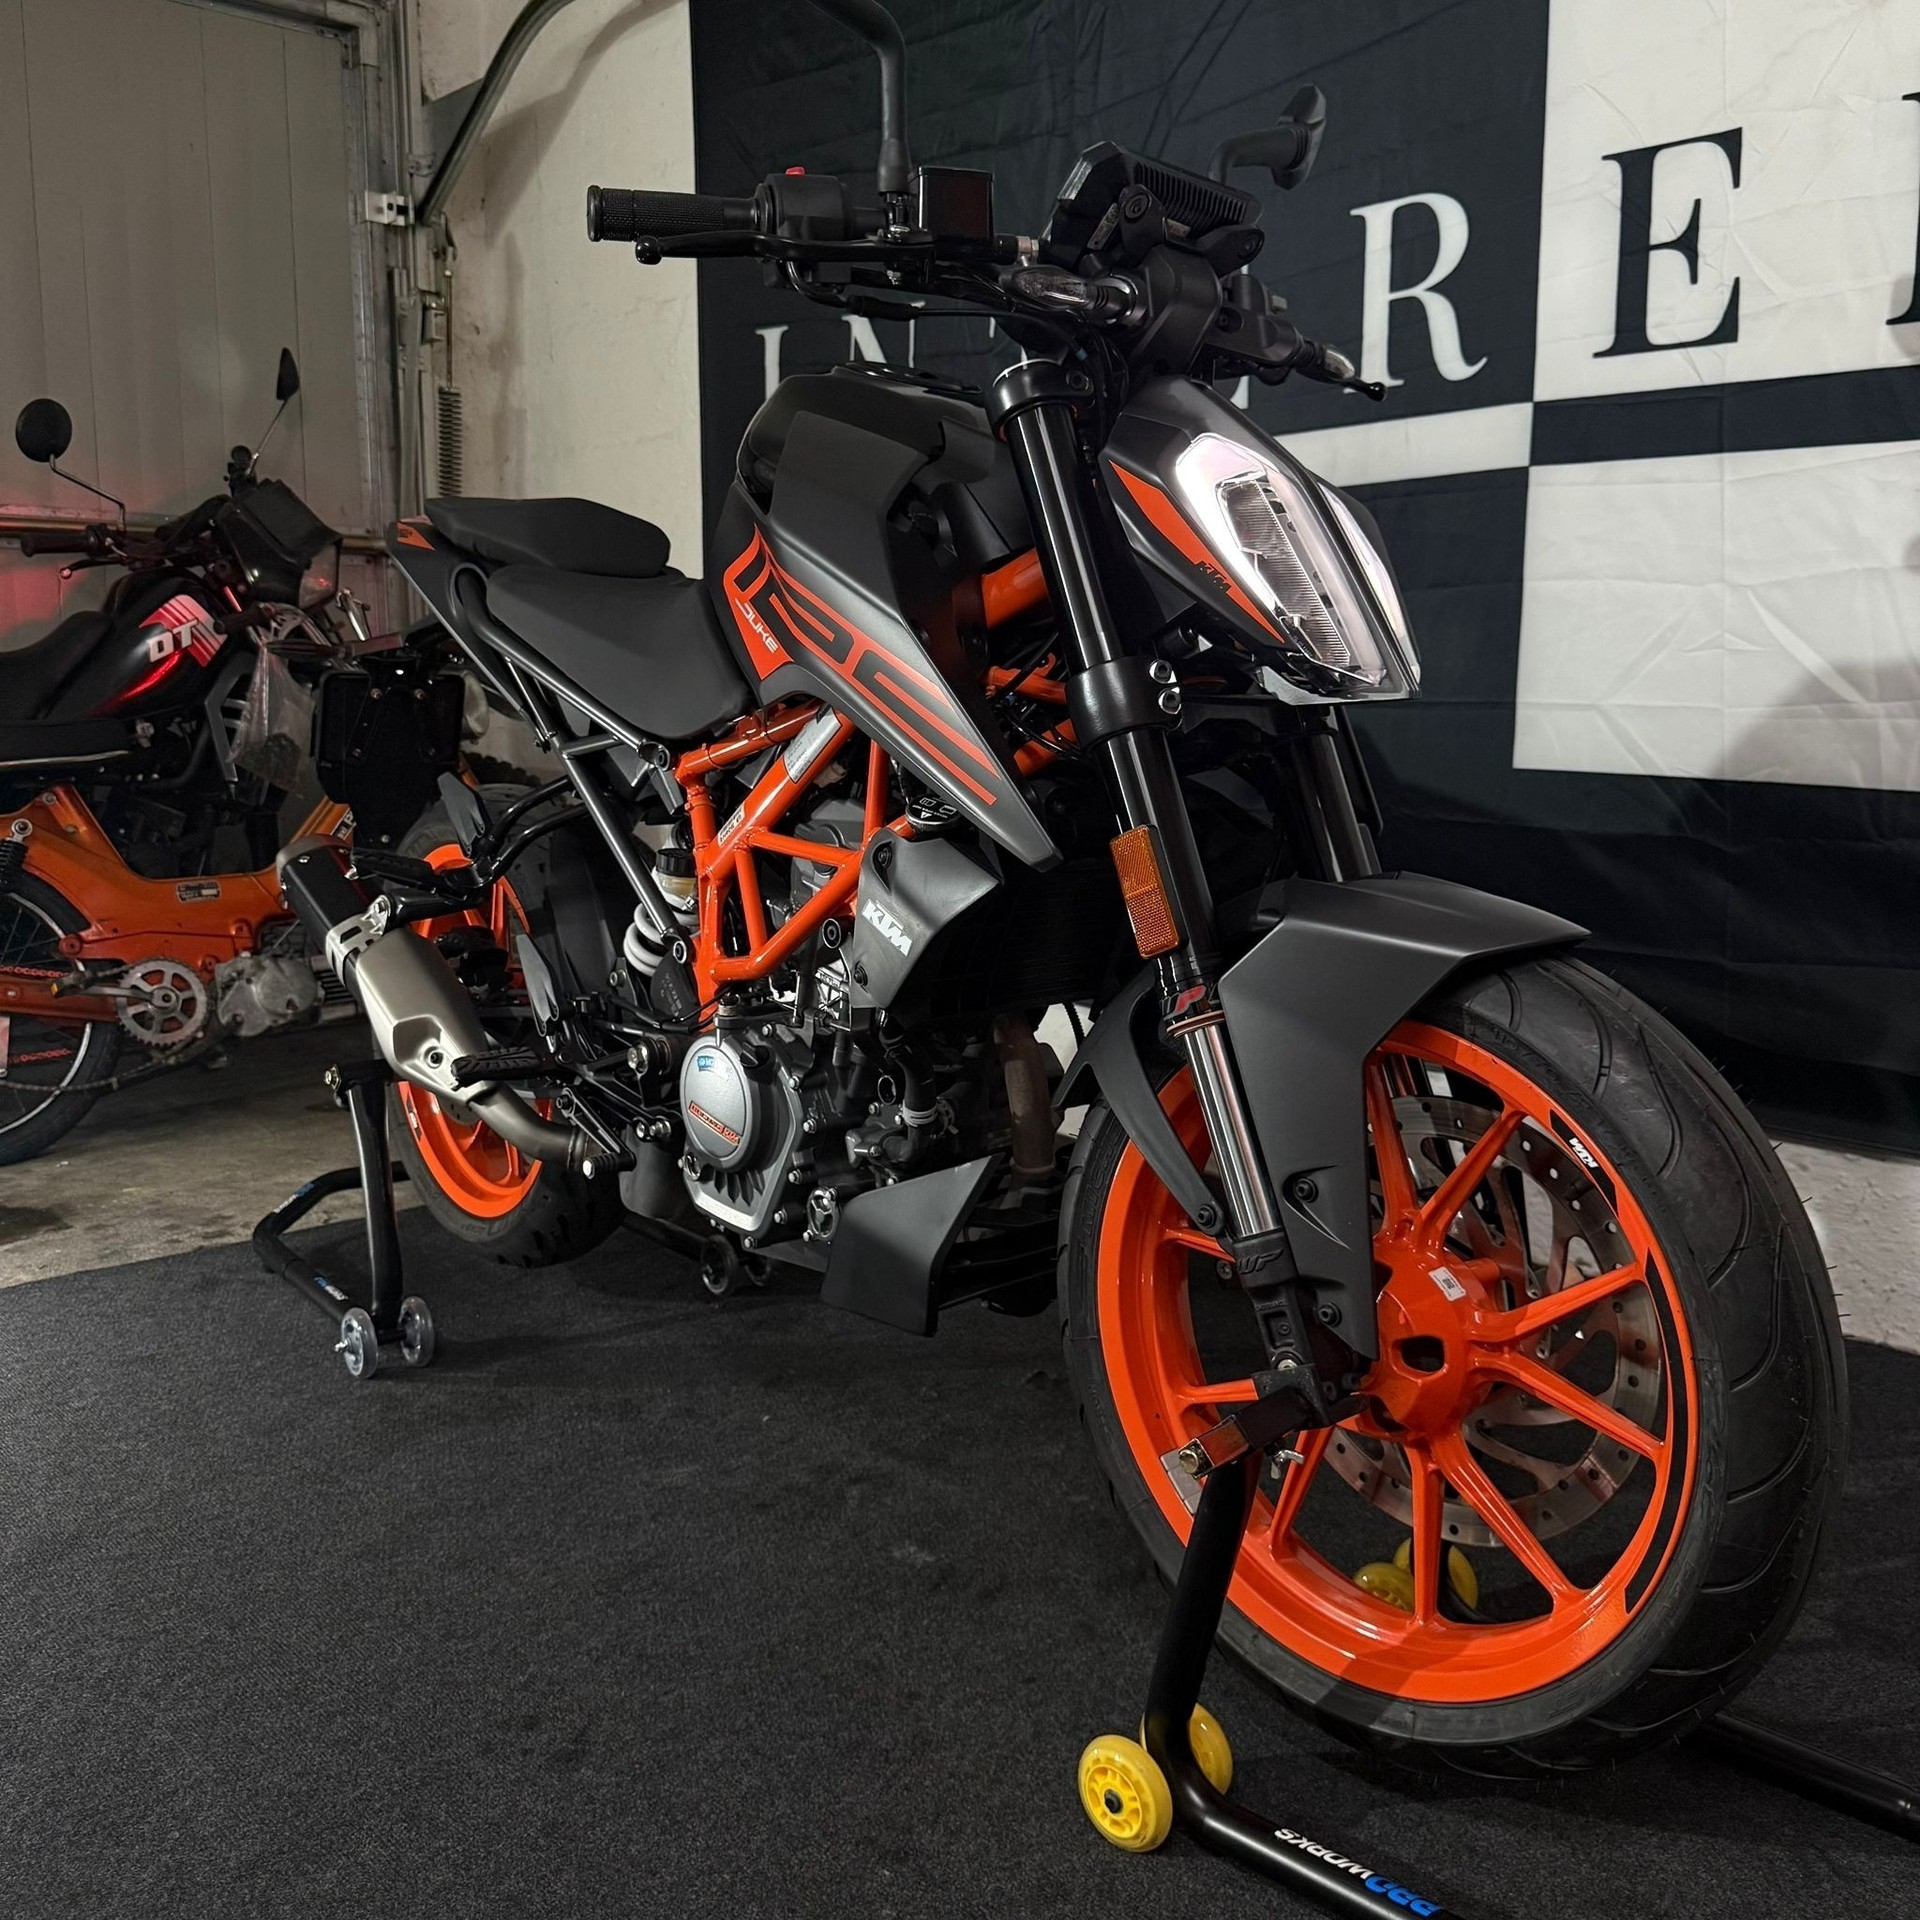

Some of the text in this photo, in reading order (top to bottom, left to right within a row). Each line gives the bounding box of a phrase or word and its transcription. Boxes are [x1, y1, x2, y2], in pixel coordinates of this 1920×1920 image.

[146, 618, 198, 663] DT
[735, 598, 779, 654] DUKE
[862, 899, 913, 957] KTM
[1568, 1137, 1599, 1168] KTM
